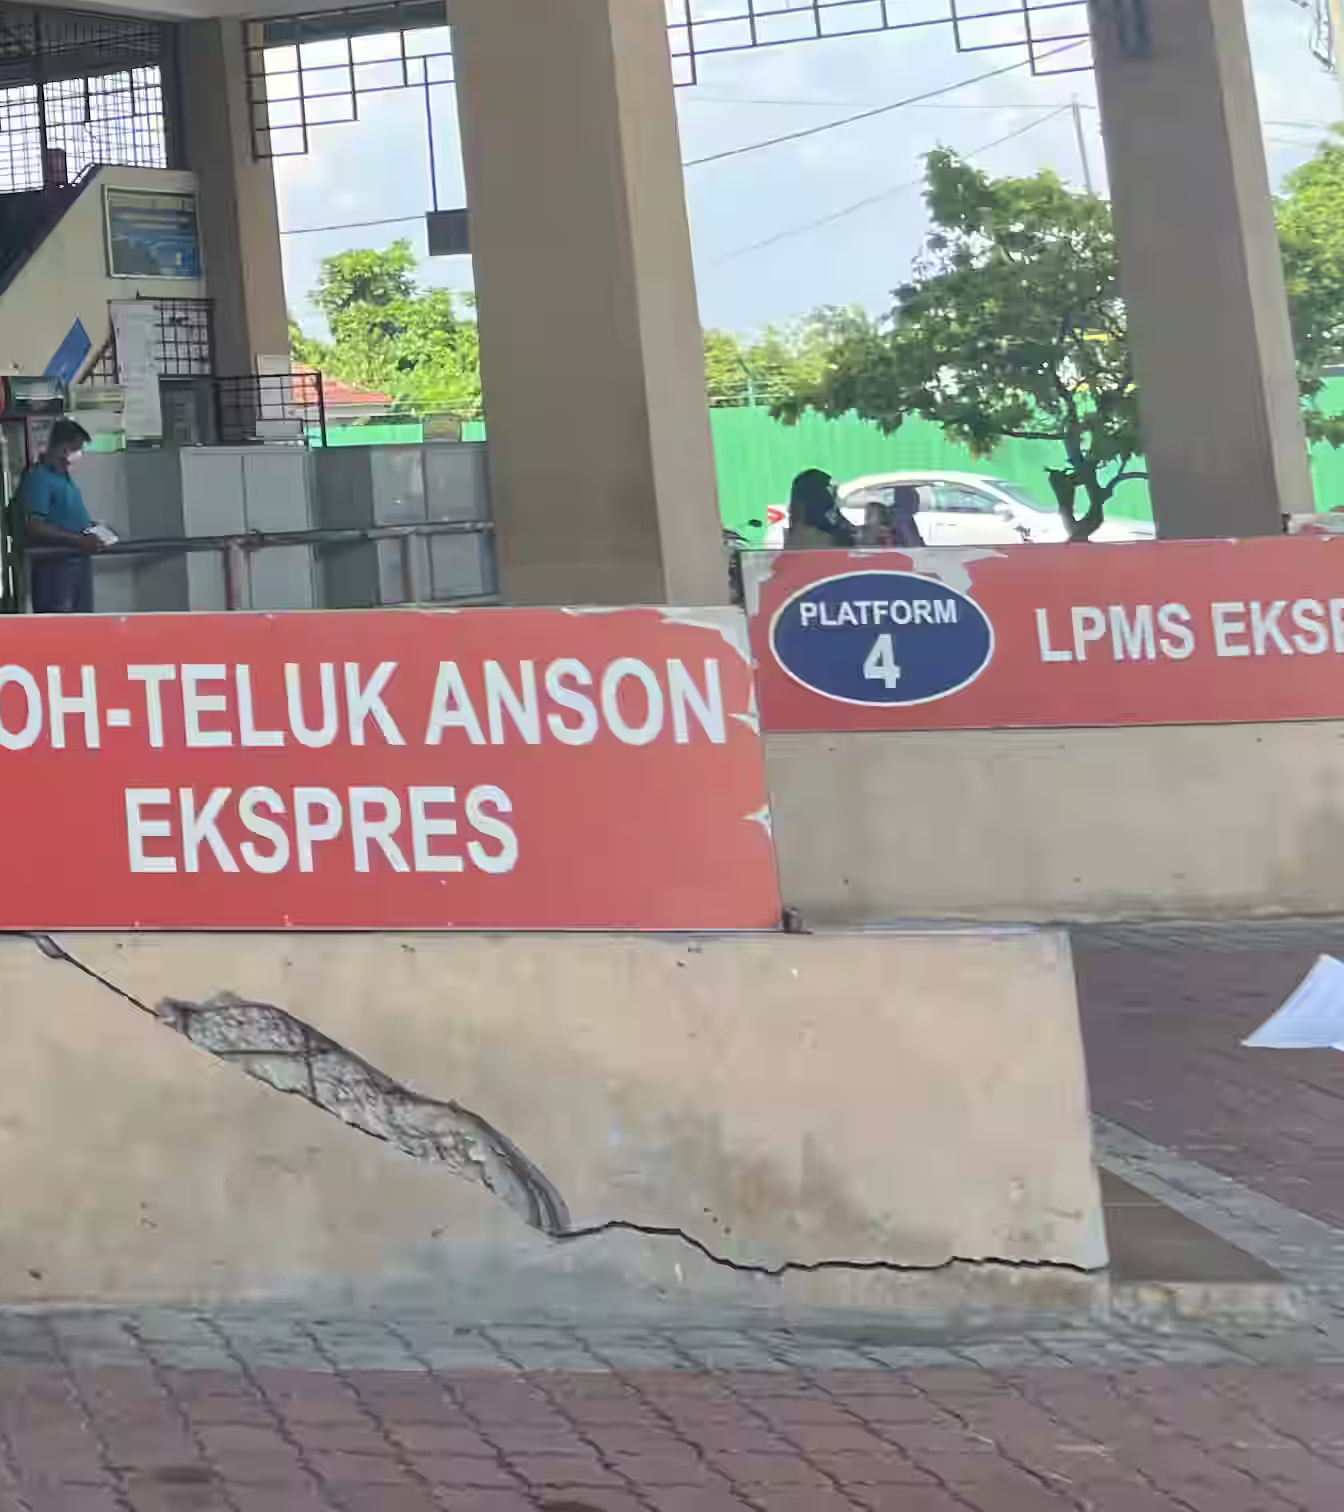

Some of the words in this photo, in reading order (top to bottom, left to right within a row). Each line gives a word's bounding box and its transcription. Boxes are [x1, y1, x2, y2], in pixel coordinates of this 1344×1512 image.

[798, 598, 958, 627] PLATFORM
[1034, 602, 1198, 663] LPMS
[862, 633, 901, 690] 4
[423, 657, 728, 747] ANSON
[124, 783, 520, 875] EKSPRES
